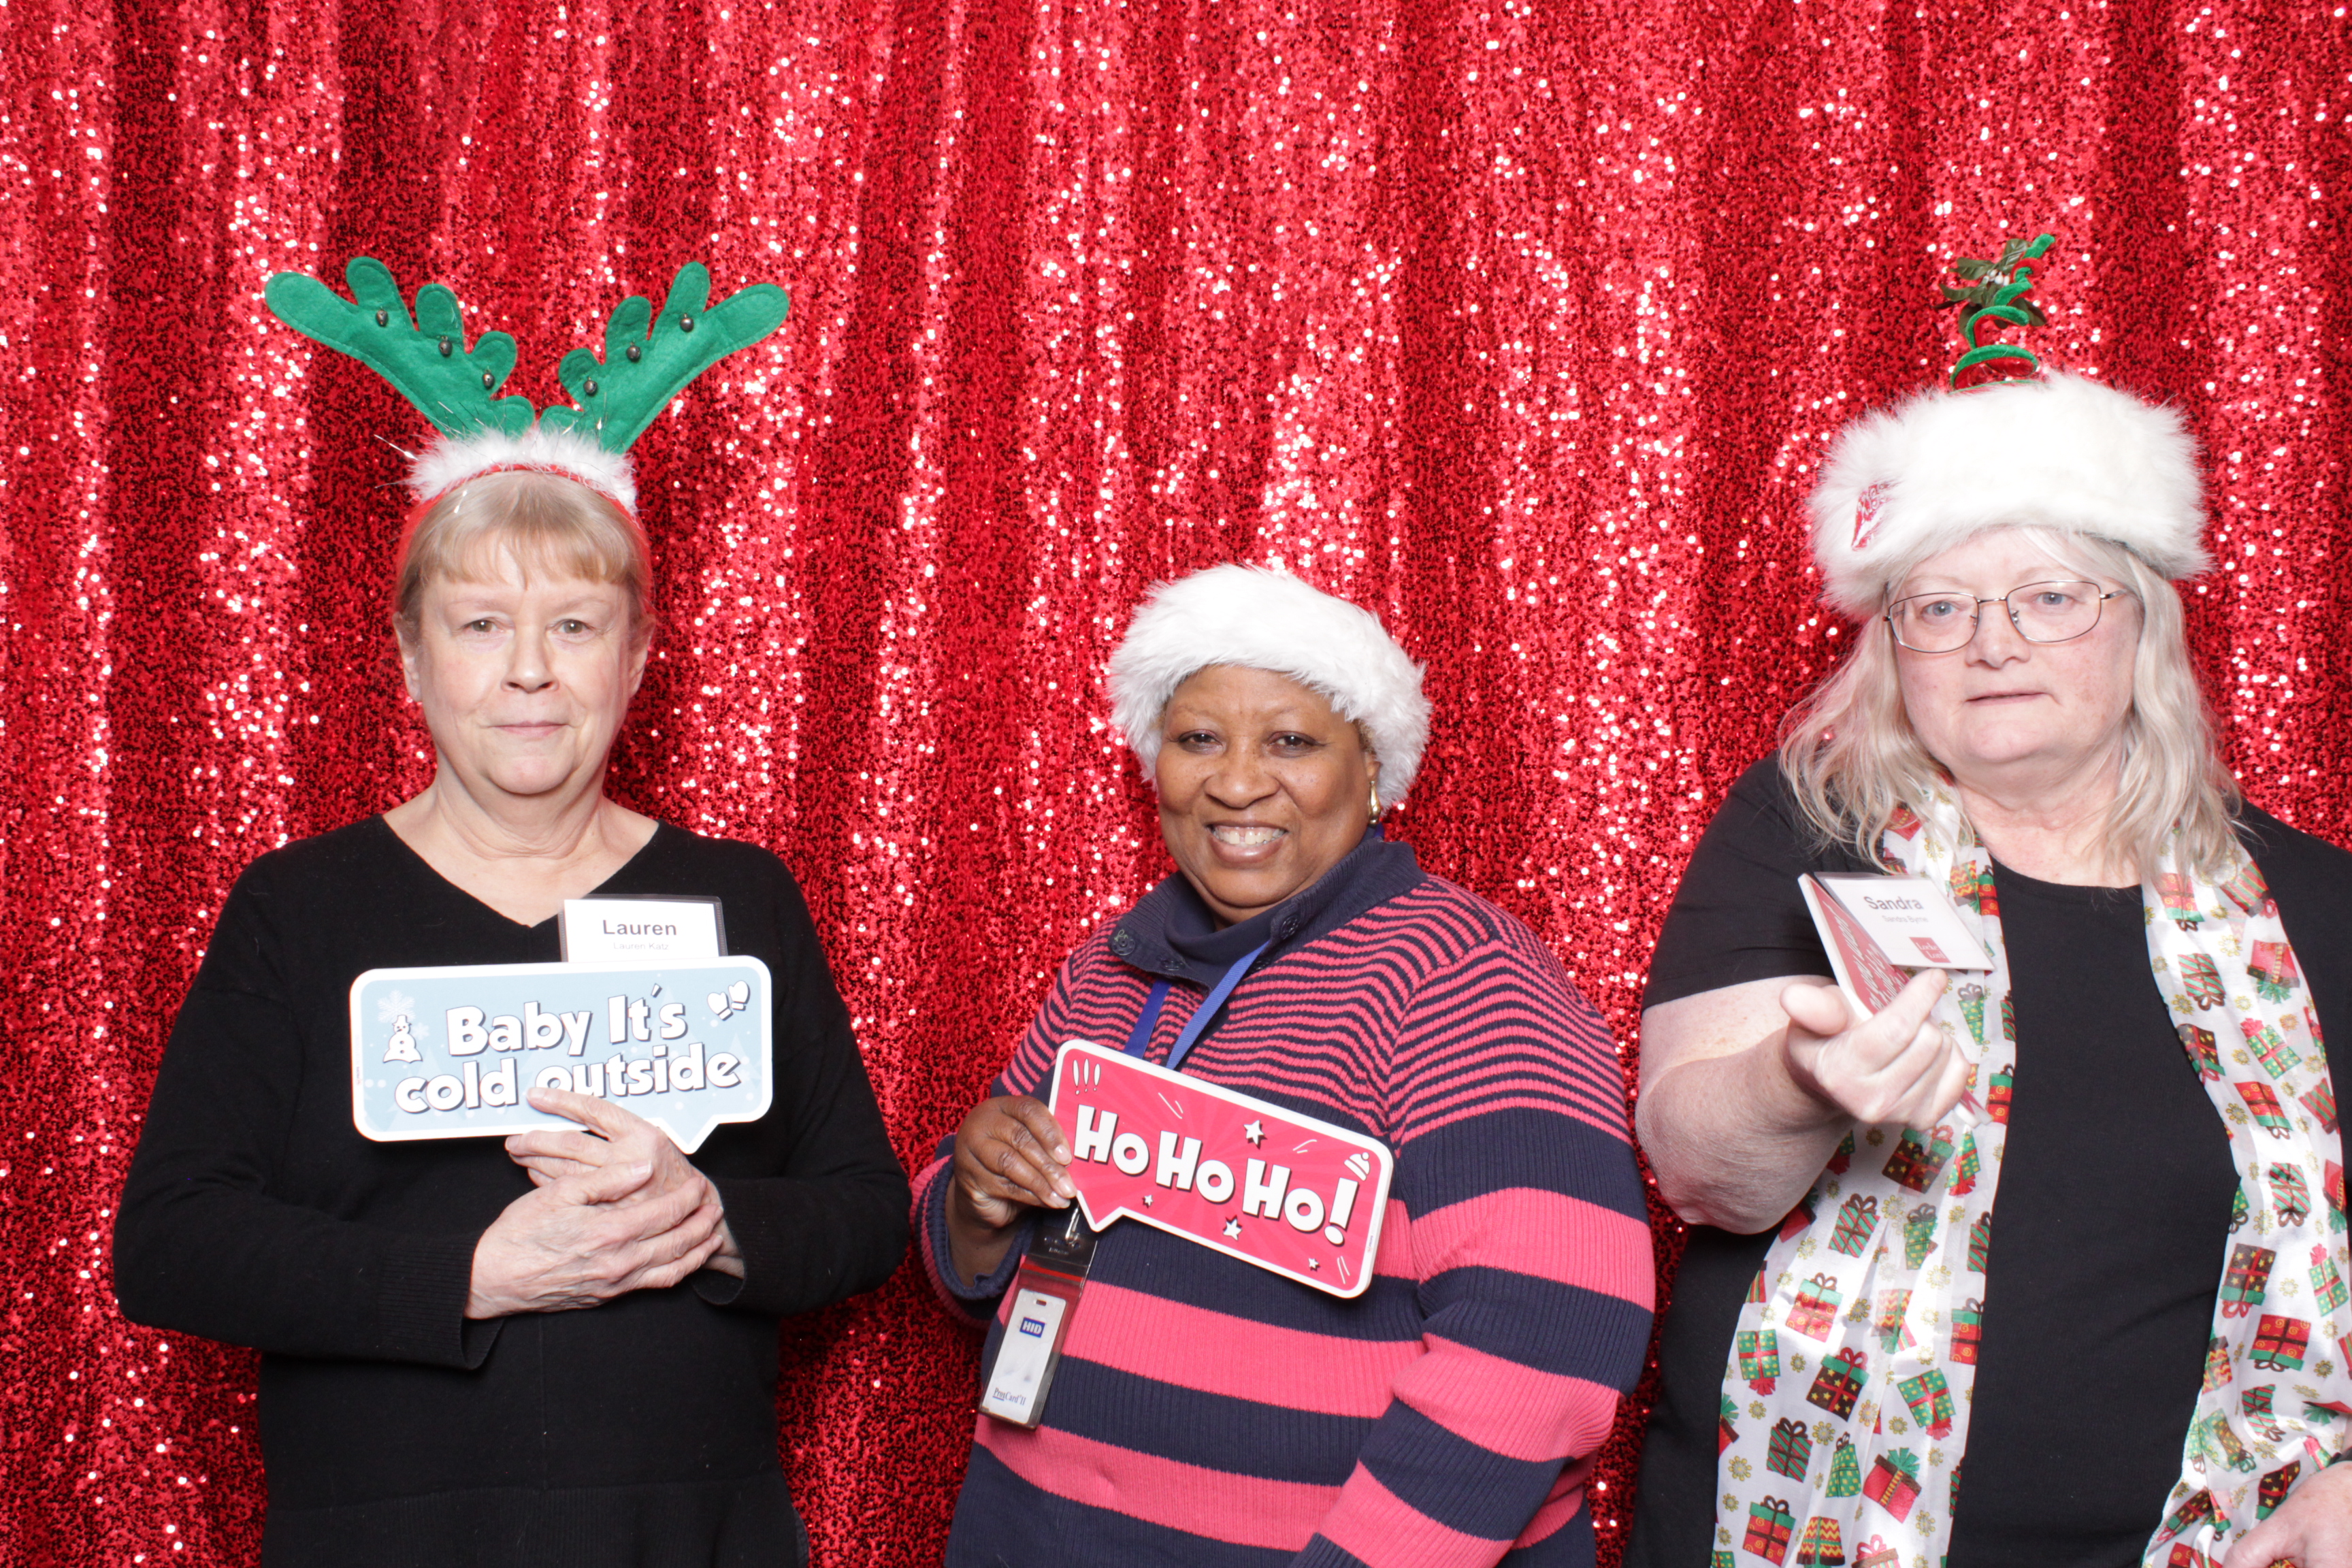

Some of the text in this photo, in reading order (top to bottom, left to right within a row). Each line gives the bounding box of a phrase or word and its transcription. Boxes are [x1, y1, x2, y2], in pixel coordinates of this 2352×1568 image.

[1863, 896, 1924, 909] Sandra
[603, 919, 677, 936] Lauren
[613, 942, 646, 950] Lauren
[446, 983, 689, 1056] Baby It's
[395, 1042, 742, 1113] cold outside
[1073, 1104, 1359, 1245] Ho Ho Ho!
[1022, 1320, 1043, 1335] HID
